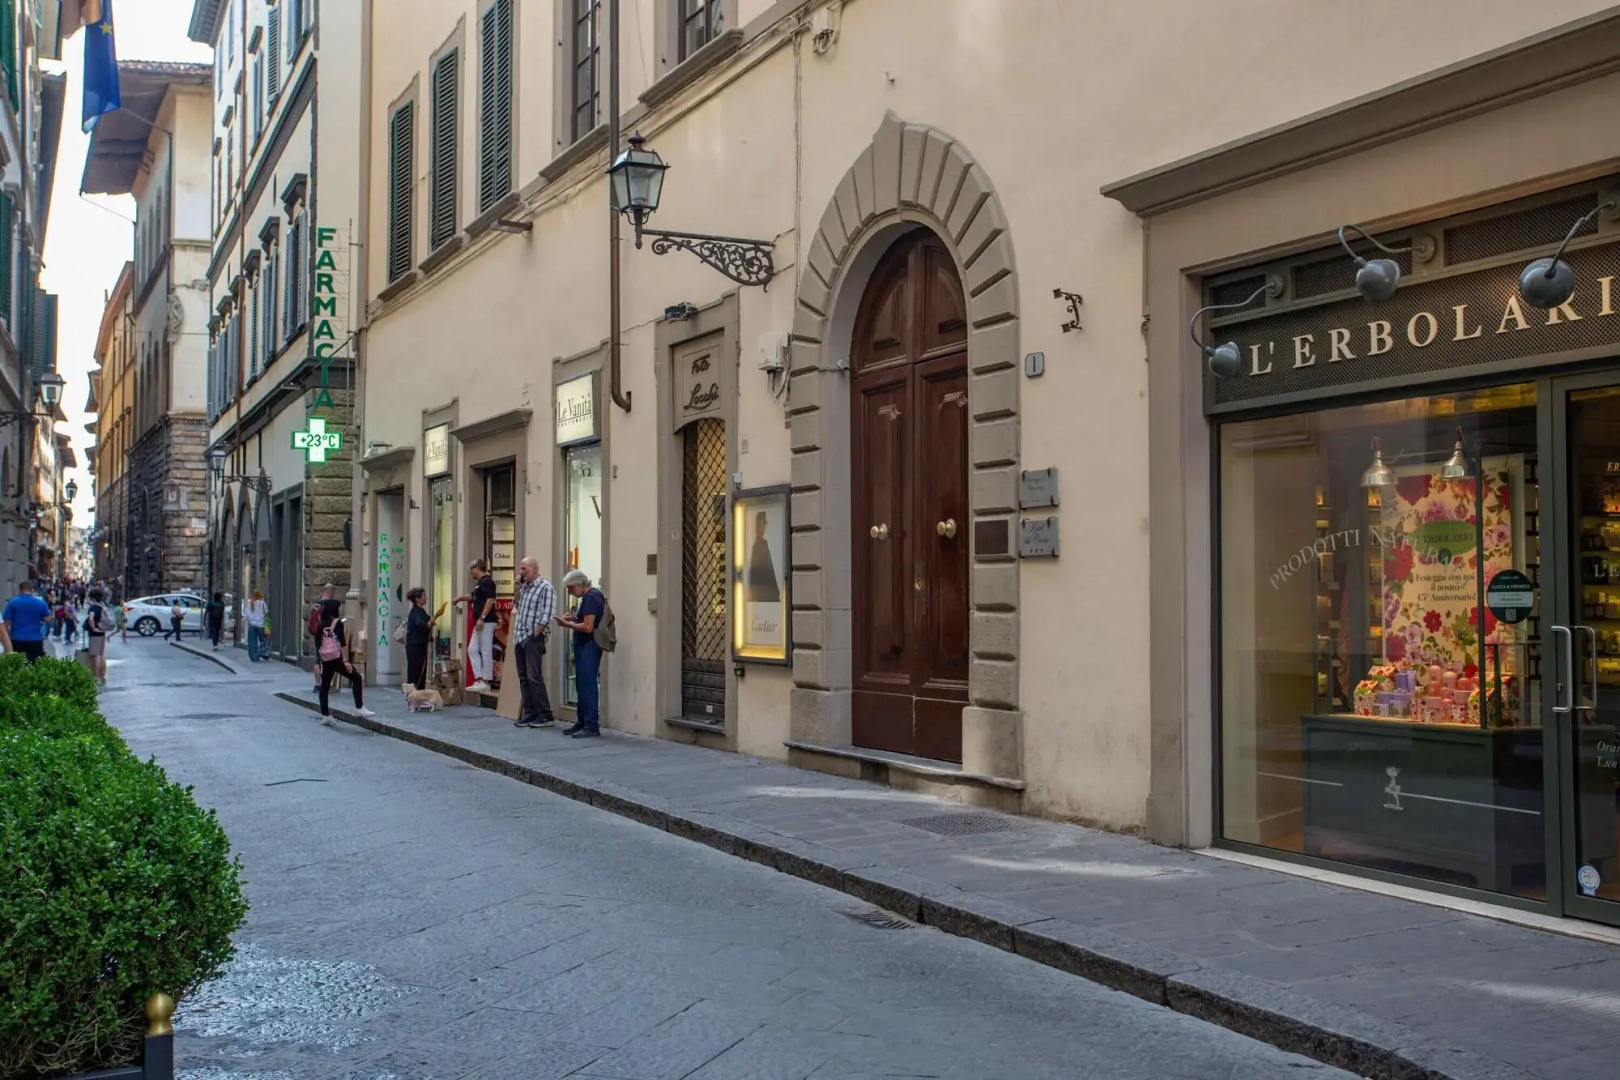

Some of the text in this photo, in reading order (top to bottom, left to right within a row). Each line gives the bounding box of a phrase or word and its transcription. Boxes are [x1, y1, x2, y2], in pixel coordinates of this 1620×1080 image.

[314, 227, 337, 409] FARMACIA
[379, 533, 390, 646] FARMACIA
[1269, 528, 1361, 590] PRODOTTI
